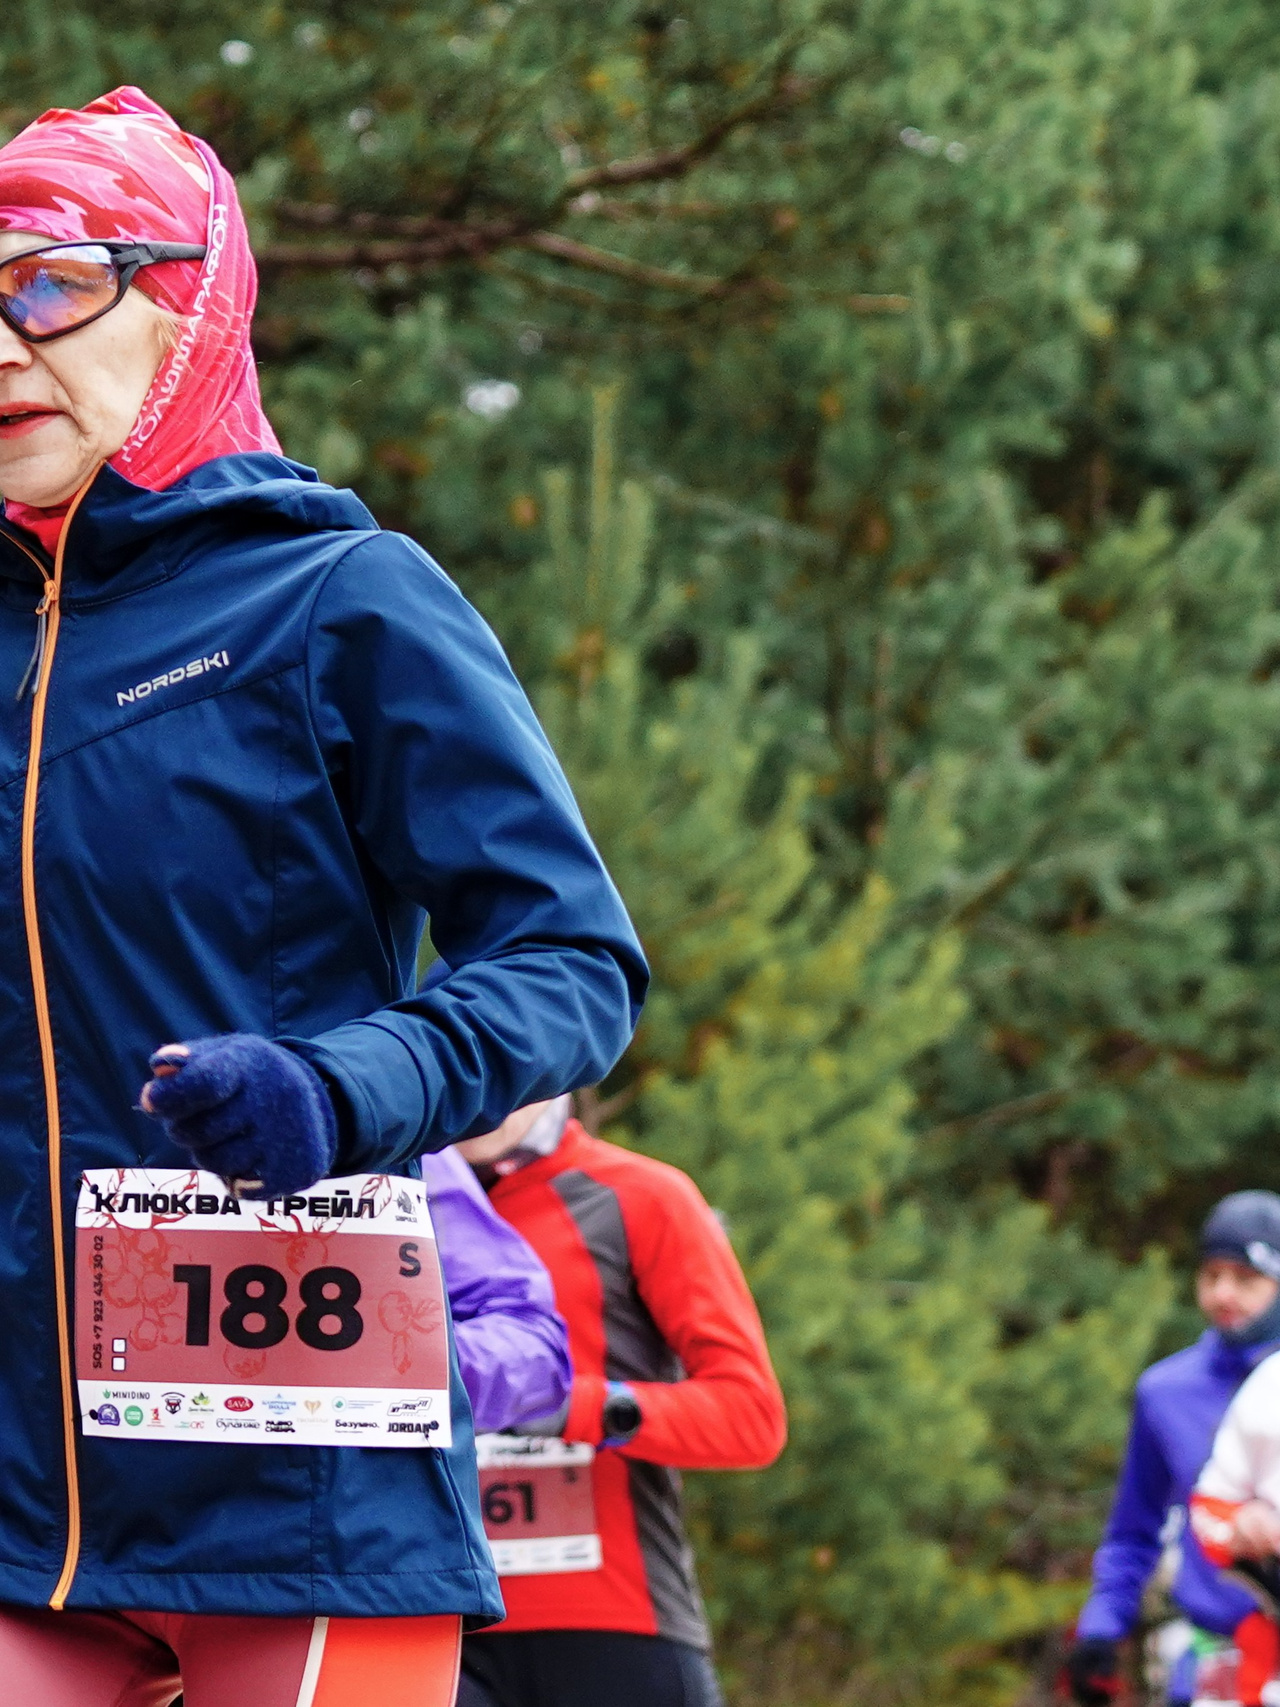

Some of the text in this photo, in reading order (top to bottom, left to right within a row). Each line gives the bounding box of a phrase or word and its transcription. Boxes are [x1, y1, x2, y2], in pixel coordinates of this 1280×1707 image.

[116, 650, 230, 707] NORDSKI
[95, 1189, 375, 1219] КЛЮКВА ТРЕЙЛ
[398, 1242, 421, 1277] S
[92, 1235, 104, 1368] SOS +7 923 434 30 02
[173, 1263, 364, 1351] 188
[112, 1391, 151, 1400] MINIDINO
[387, 1422, 429, 1434] JORDAN
